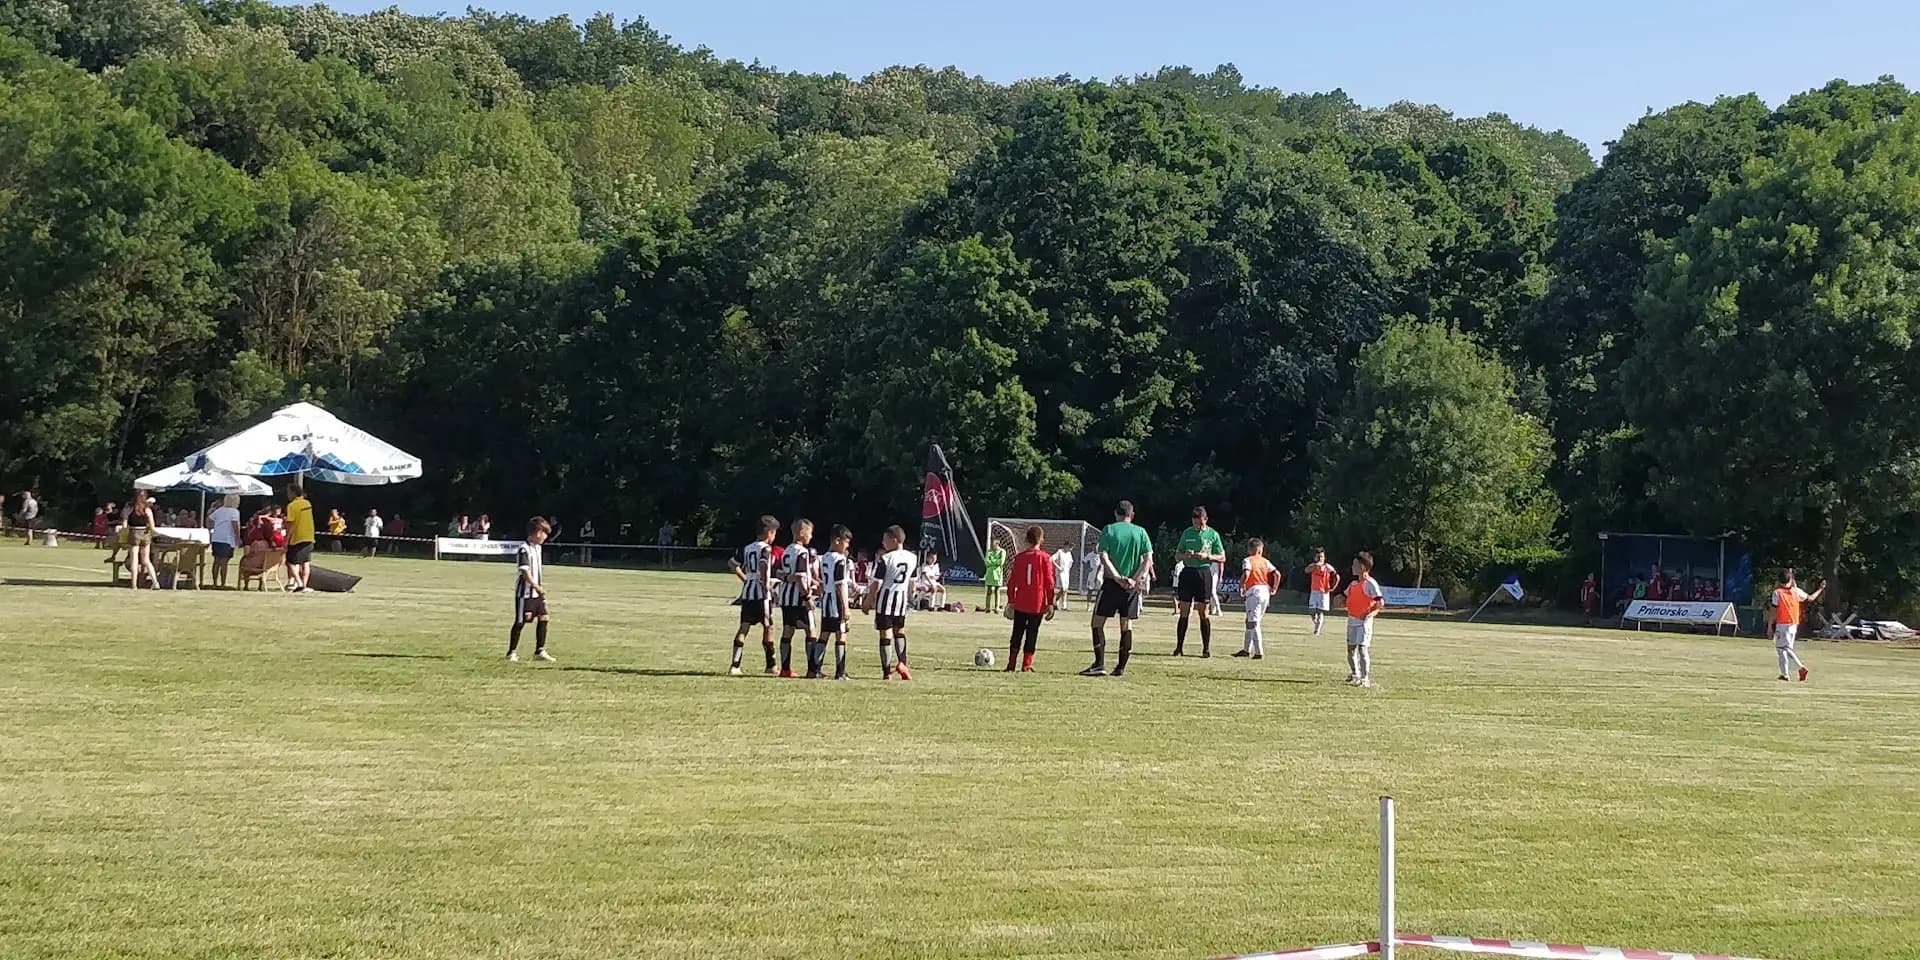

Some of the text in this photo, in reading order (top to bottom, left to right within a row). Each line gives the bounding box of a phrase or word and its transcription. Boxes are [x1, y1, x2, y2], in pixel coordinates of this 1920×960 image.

[893, 562, 909, 584] 3
[1026, 563, 1033, 586] 1
[1637, 605, 1689, 617] Primorsko
